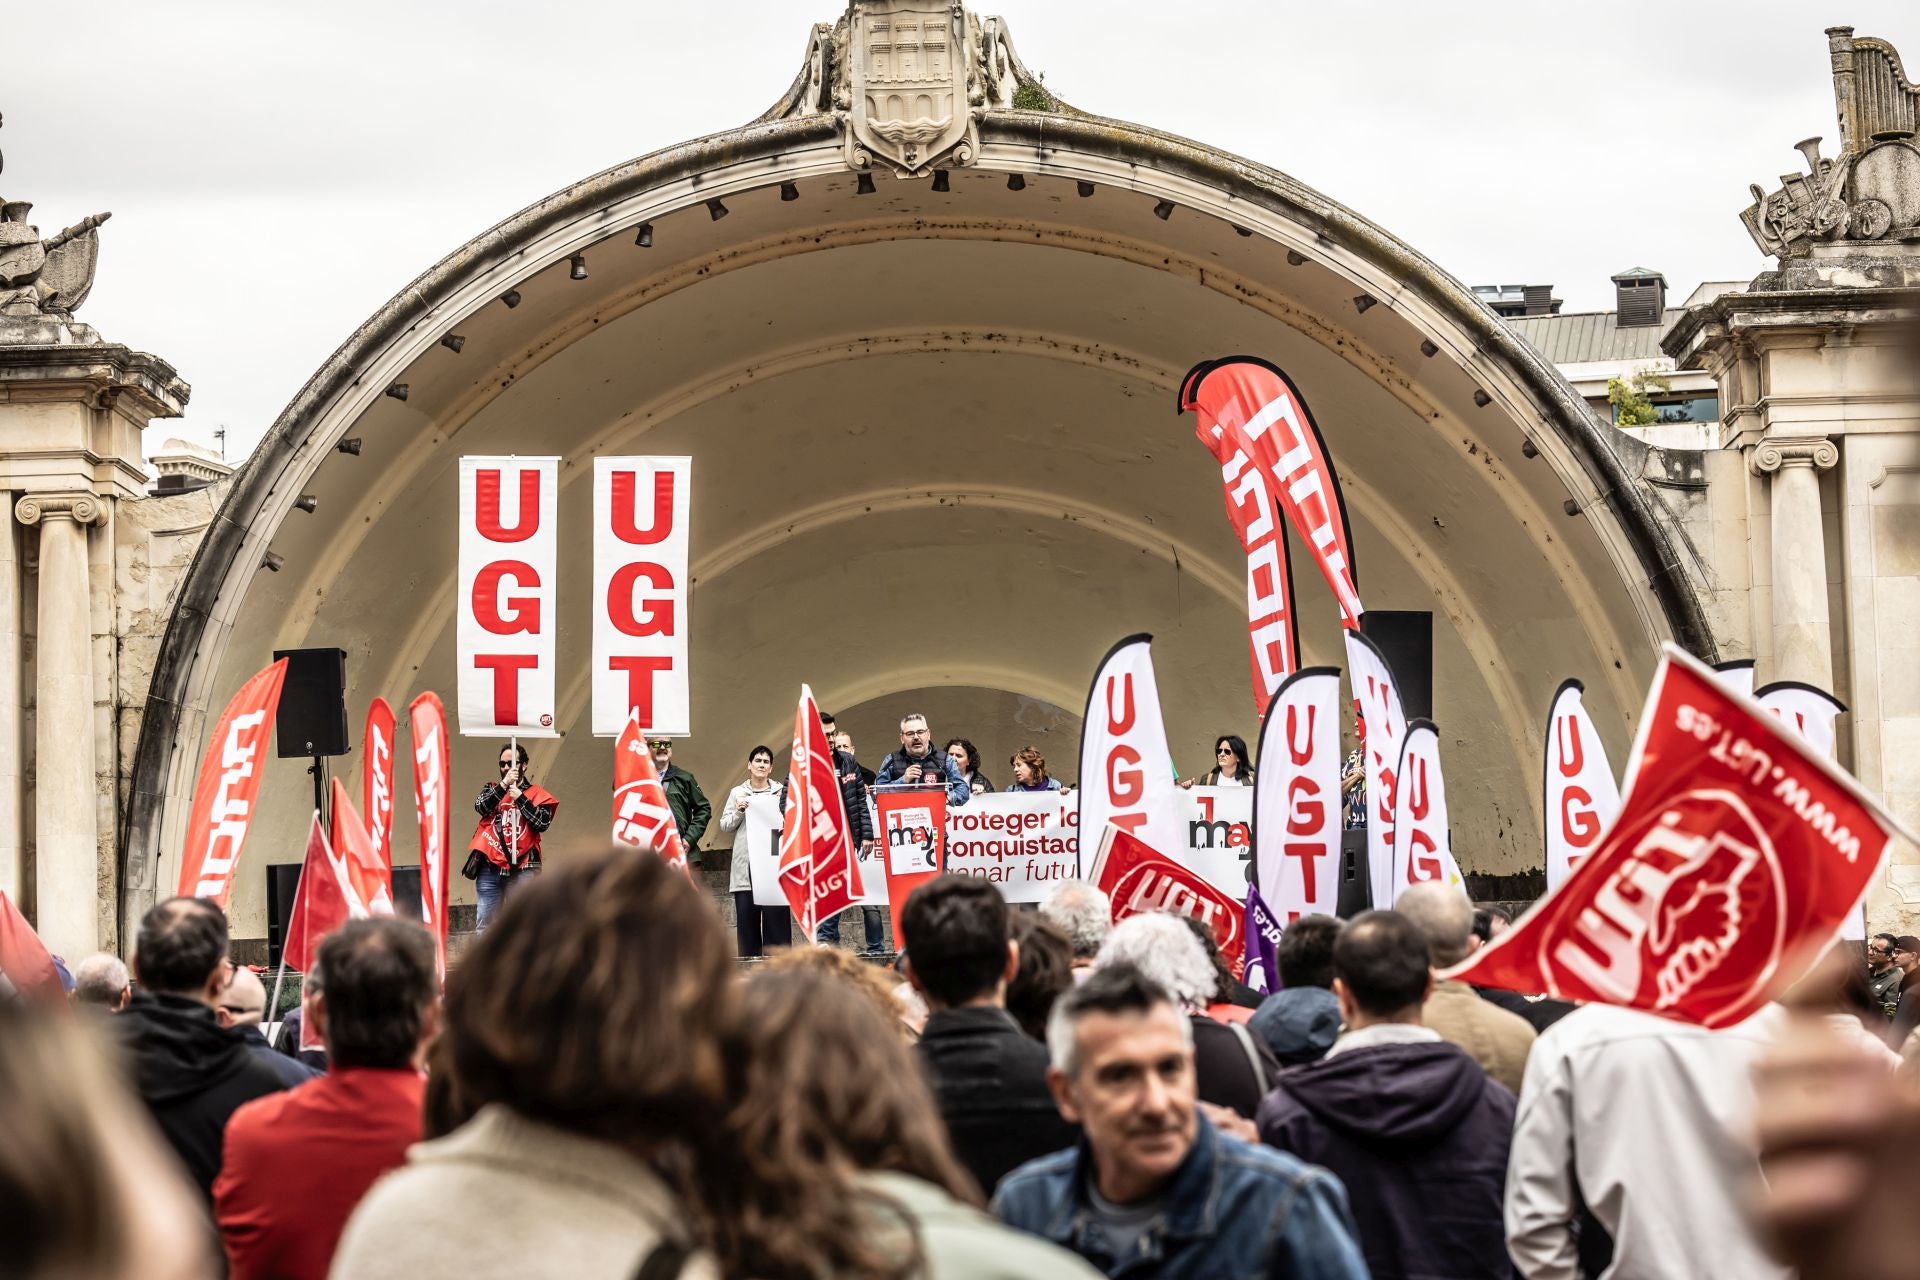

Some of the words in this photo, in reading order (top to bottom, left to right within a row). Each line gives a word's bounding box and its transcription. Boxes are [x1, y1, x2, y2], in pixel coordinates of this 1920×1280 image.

[471, 468, 541, 726] UGT
[607, 470, 675, 729] UGT
[1284, 704, 1327, 904] UGT
[1558, 715, 1602, 870] UG
[1554, 811, 1708, 1002] UGT
